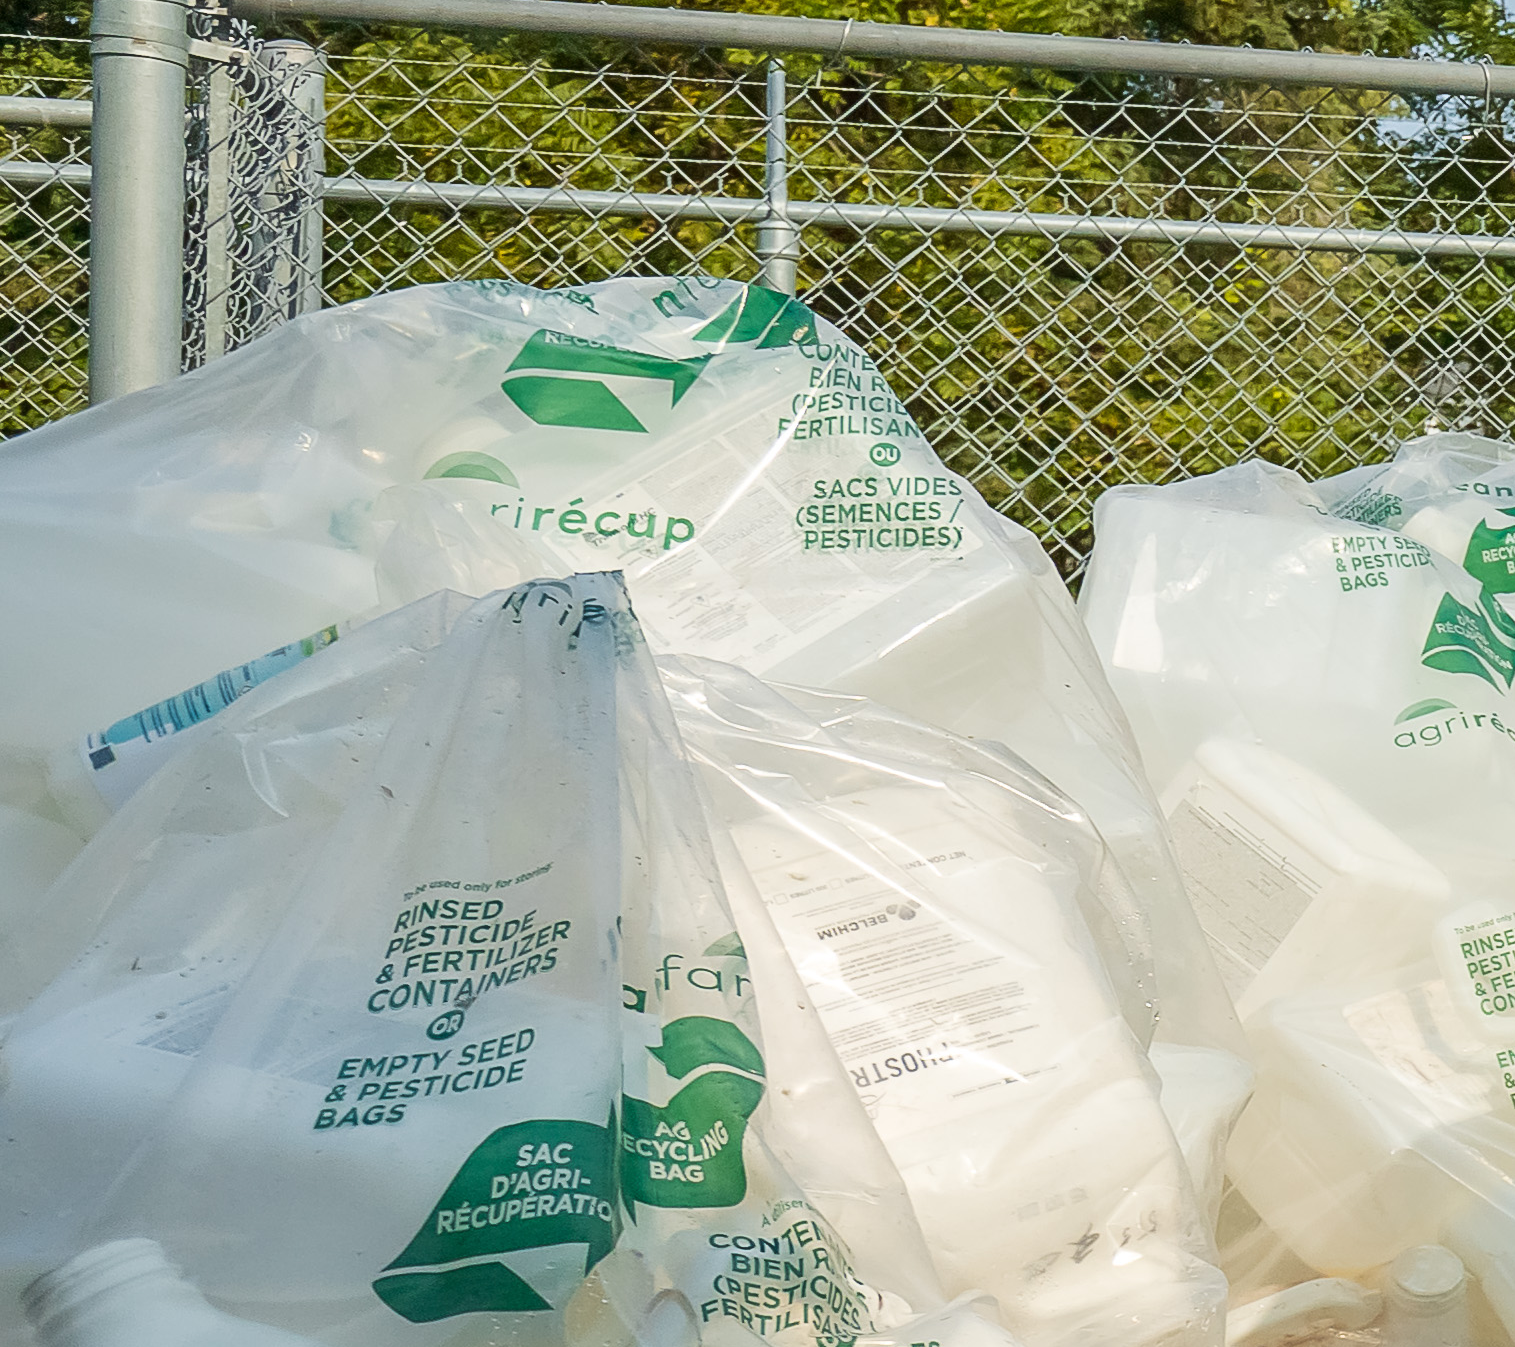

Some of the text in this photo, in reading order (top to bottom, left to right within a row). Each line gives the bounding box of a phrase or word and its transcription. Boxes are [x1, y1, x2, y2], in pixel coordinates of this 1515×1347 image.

[813, 476, 962, 500] SACS VIDES
[796, 499, 964, 528] (SEMENCES /
[803, 525, 964, 550] PESTICIDES)
[1331, 535, 1388, 554] EMPTY
[1335, 557, 1348, 573] &
[1339, 571, 1389, 593] BAGS
[393, 899, 504, 934] RINSED
[816, 913, 889, 941] BELCHIM
[385, 909, 538, 959] PESTICIDE
[375, 919, 572, 985] & FERTILIZER
[367, 946, 559, 1014] CONTAINERS
[1474, 982, 1487, 997] &
[336, 1027, 536, 1080] EMPTY SEED
[324, 1058, 528, 1104] & PESTICIDE
[1503, 1071, 1515, 1089] &
[313, 1103, 407, 1130] BAGS
[654, 1120, 692, 1142] AG
[515, 1142, 574, 1167] SAC
[490, 1168, 592, 1200] D'AGRI-
[649, 1160, 705, 1184] BAG
[730, 1253, 805, 1282] BIEN
